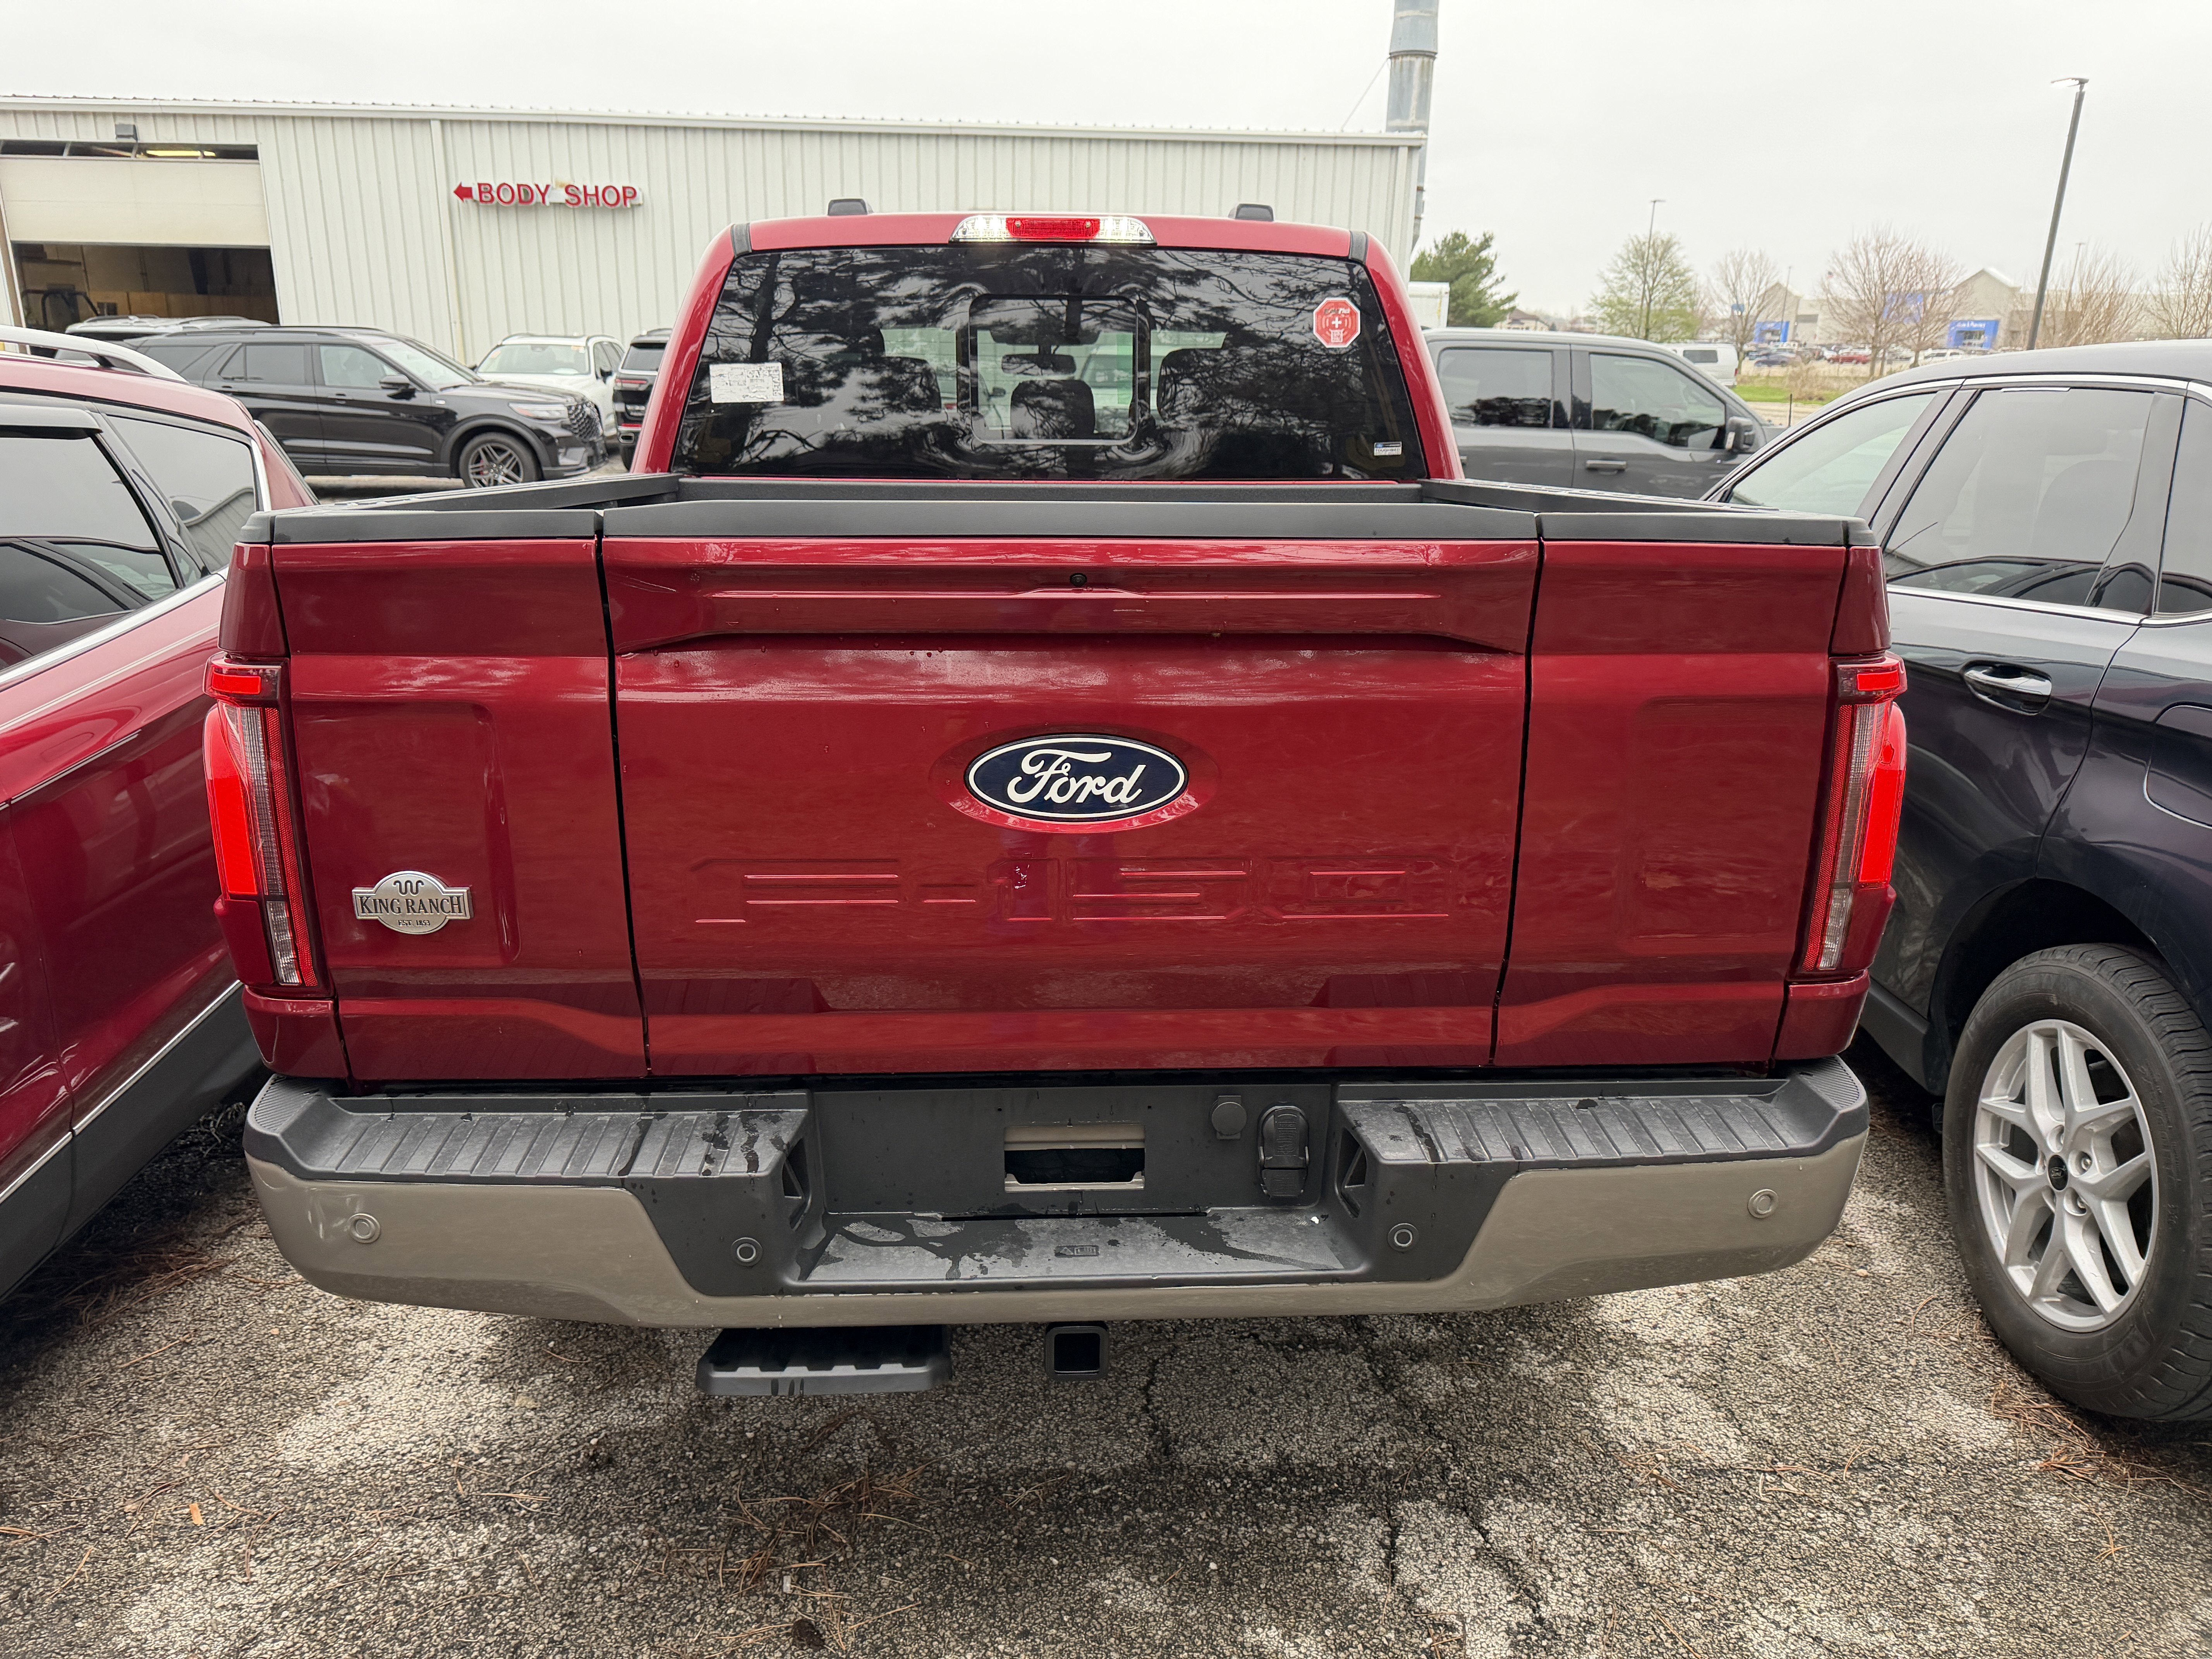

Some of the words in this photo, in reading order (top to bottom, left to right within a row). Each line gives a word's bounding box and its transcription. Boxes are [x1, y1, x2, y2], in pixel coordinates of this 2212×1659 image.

[477, 182, 551, 206] BODY
[564, 184, 637, 208] SHOP
[1006, 749, 1147, 804] Ford
[358, 896, 402, 915] KING
[405, 896, 464, 914] RANCH
